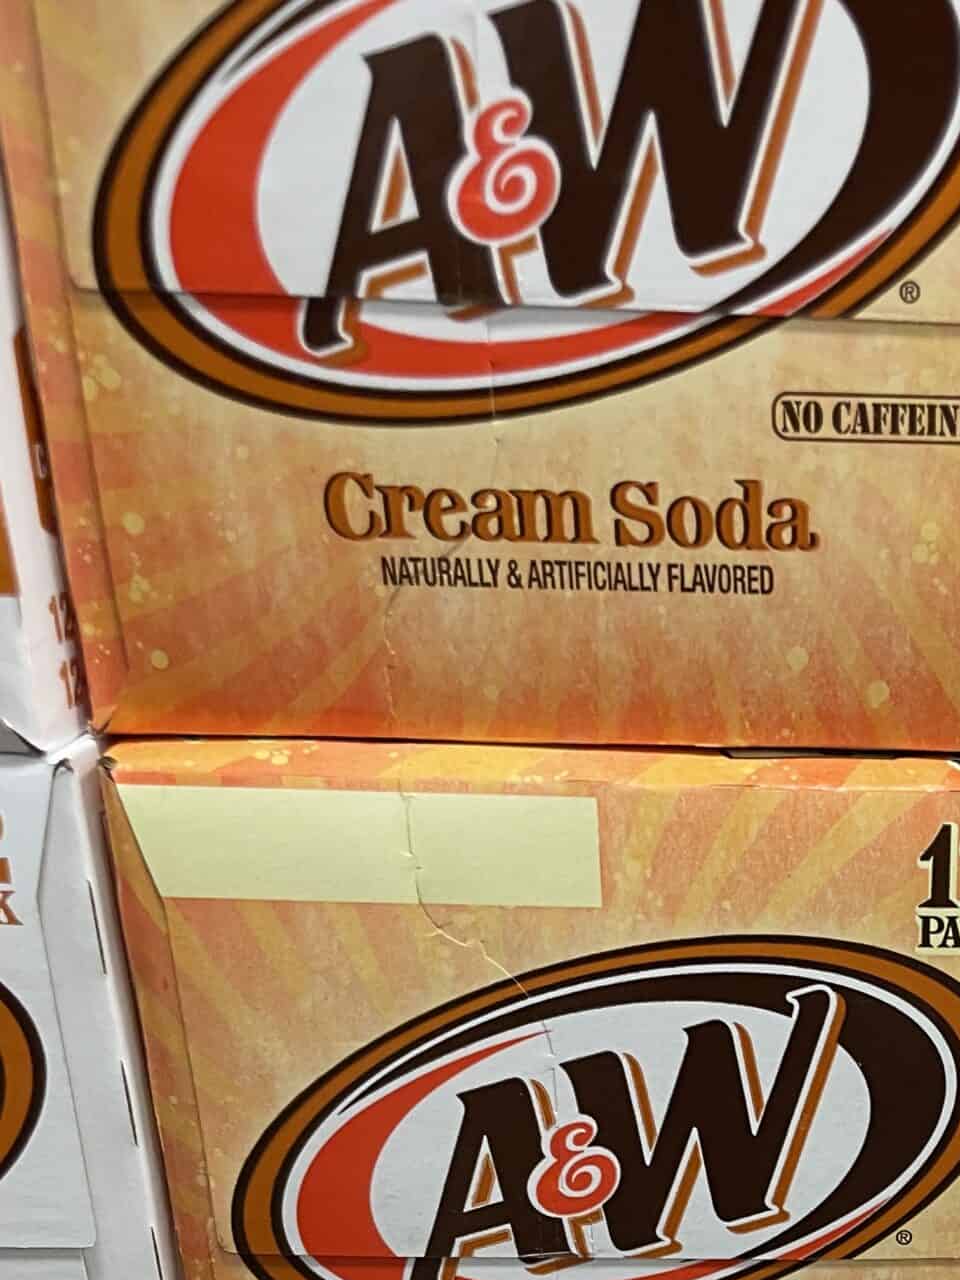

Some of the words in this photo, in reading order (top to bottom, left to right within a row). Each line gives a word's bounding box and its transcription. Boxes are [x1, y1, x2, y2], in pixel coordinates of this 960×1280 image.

[296, 0, 820, 366] A&W
[781, 399, 824, 435] NO
[323, 471, 600, 548] Cream
[609, 479, 820, 552] Soda
[381, 555, 500, 589] NATURALLY
[507, 559, 523, 589] &
[527, 558, 662, 593] ARTIFICIALLY
[667, 562, 774, 596] FLAVORED
